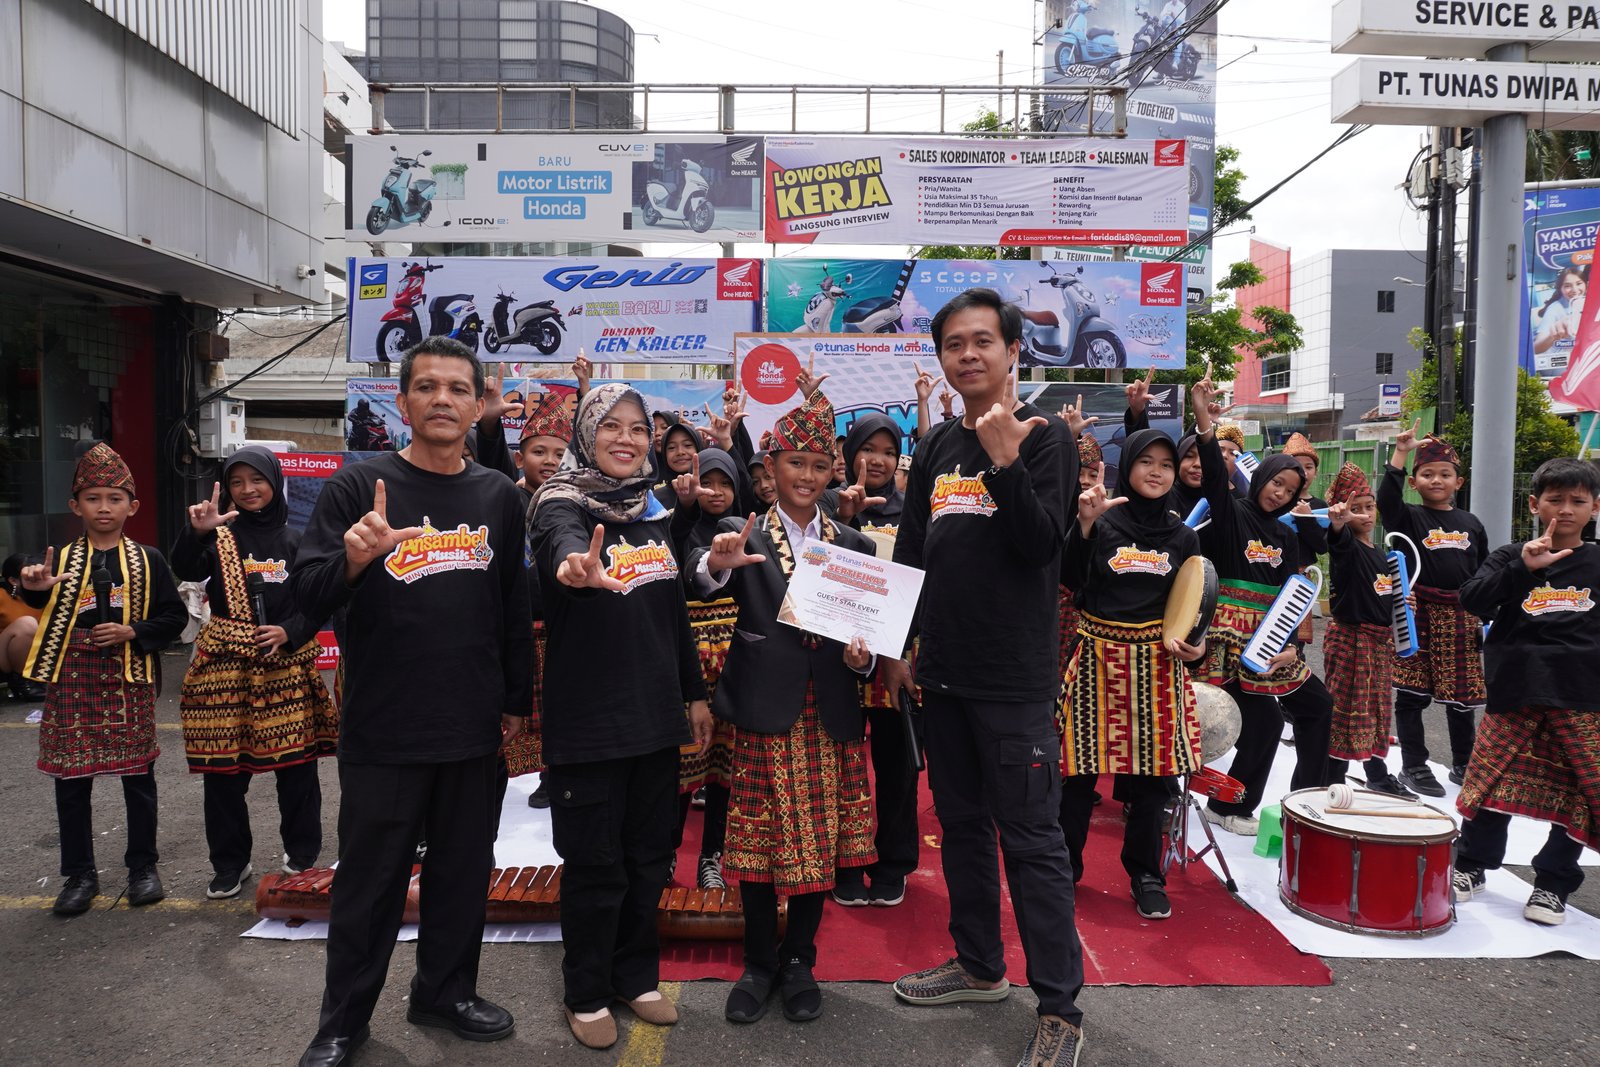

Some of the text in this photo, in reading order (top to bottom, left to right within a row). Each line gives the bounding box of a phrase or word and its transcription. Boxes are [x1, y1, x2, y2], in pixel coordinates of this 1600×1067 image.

[1416, 0, 1599, 29] SERVICE & PA
[1378, 71, 1411, 95] PT.
[1419, 72, 1498, 98] TUNAS
[1507, 75, 1579, 101] DWIPA
[1137, 101, 1175, 121] TOGETHER
[598, 144, 631, 152] CUV
[538, 156, 571, 167] BARU
[909, 149, 1149, 165] SALES KORDINATOR TEAM LEADER SALESMAN
[773, 157, 881, 188] LOWONGAN
[918, 176, 973, 184] PERSYARATAN
[1053, 176, 1085, 184] BENEFIT
[503, 174, 607, 190] Motor Listrik
[924, 185, 961, 193] Pria/Wanita
[776, 175, 890, 219] KERJA
[528, 200, 582, 216] Honda
[1058, 202, 1091, 210] Rewarding
[789, 211, 890, 232] LANGSUNG INTERVIEW
[923, 210, 948, 218] Mampu
[995, 210, 1020, 218] Dengan
[1058, 210, 1082, 218] Jenjang
[923, 218, 971, 226] Berpenampilan
[1090, 233, 1181, 243] faridadis89@gmail.com
[1541, 227, 1582, 243] YANG
[1054, 250, 1064, 260] JL.
[542, 261, 716, 292] Genio
[920, 271, 1015, 283] SCOOPY
[363, 287, 384, 296] ホンダ
[621, 299, 672, 316] BARU
[602, 326, 655, 336] DUNIANYA
[594, 334, 707, 353] GEN KALCER
[823, 342, 890, 352] tunas Honda
[375, 382, 398, 391] Honda
[278, 457, 338, 469] nas Honda
[393, 526, 487, 565] Ansambel
[426, 547, 470, 562] Musik
[1113, 549, 1168, 564] Ansambel
[634, 560, 664, 574] Musik
[842, 555, 862, 567] tunas
[861, 561, 885, 573] Honda
[404, 571, 421, 583] MIN
[428, 562, 455, 574] Bandar
[456, 561, 488, 570] Lampung
[827, 563, 888, 587] SERTIFIKAT
[816, 591, 880, 615] GUEST STAR EVENT
[1525, 587, 1590, 606] Ansambel
